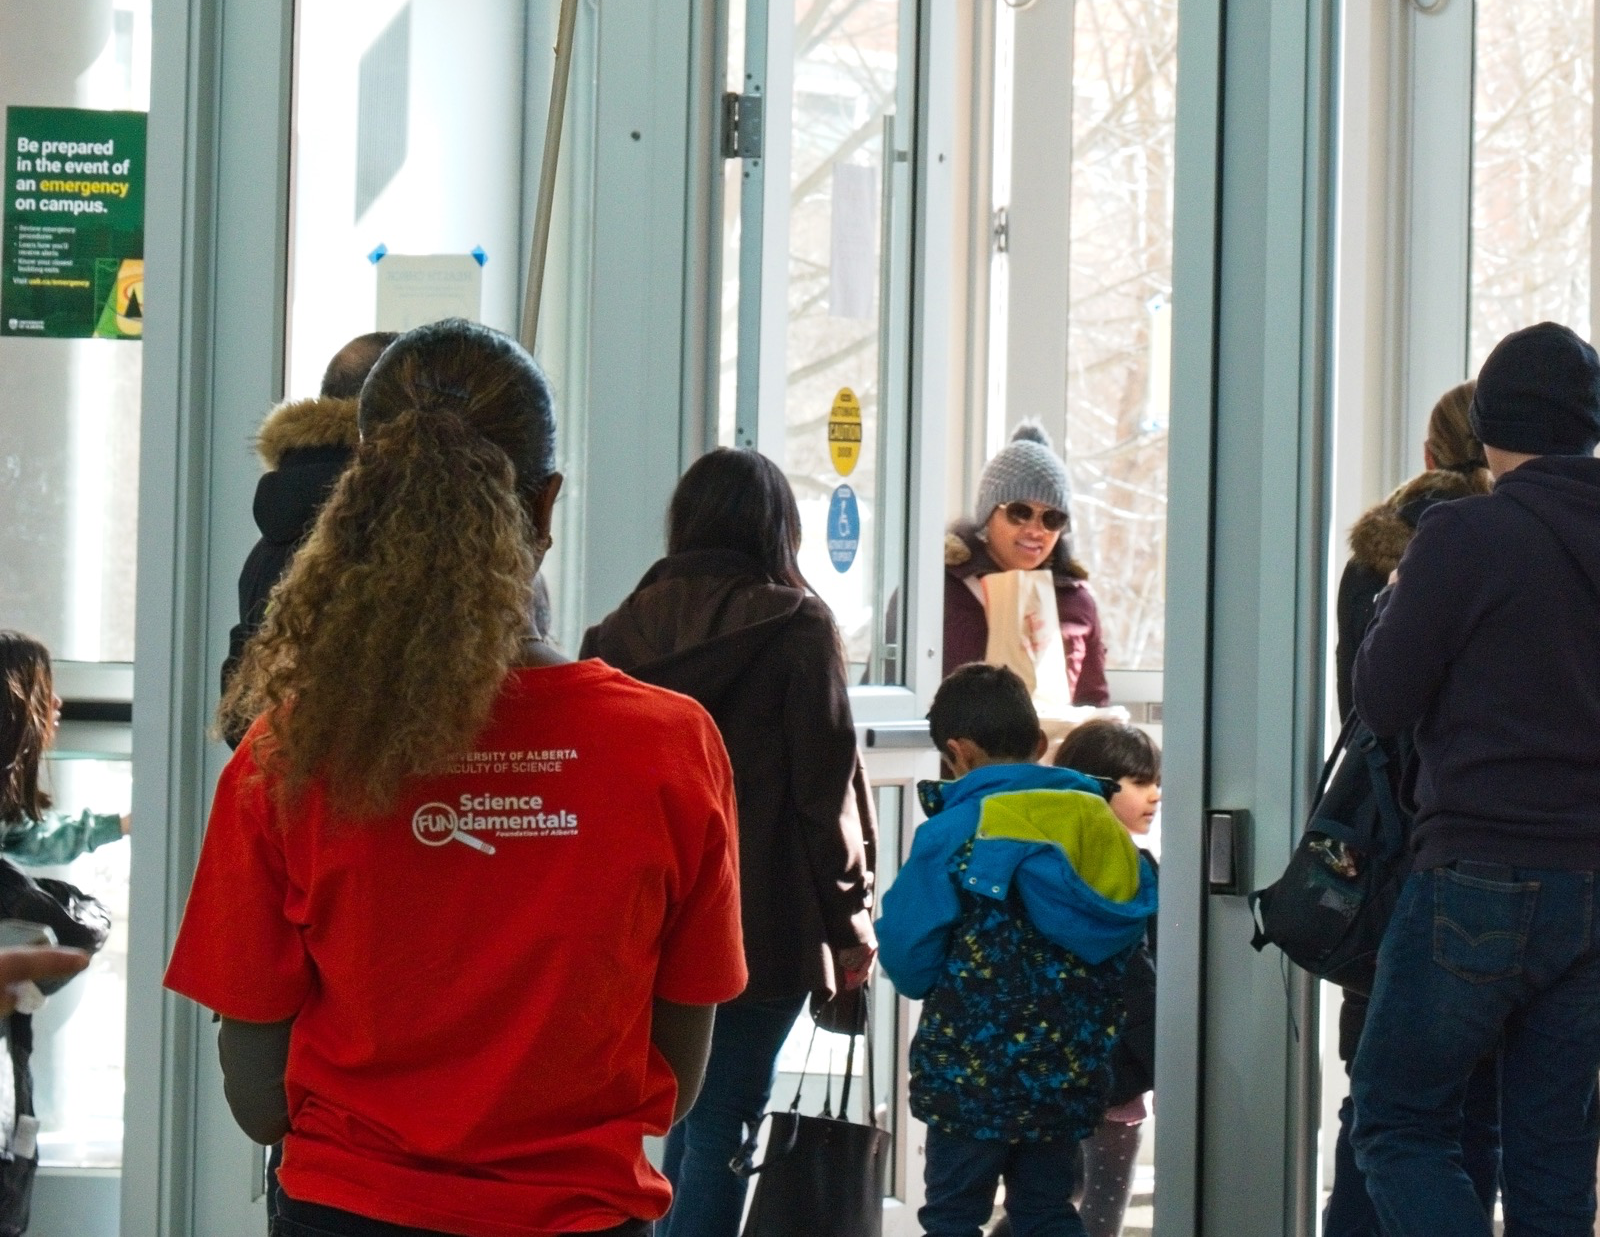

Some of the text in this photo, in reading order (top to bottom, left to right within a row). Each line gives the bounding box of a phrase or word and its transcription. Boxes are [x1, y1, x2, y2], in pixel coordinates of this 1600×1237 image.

[17, 137, 114, 158] Be prepared
[16, 156, 130, 175] in the event of
[16, 178, 129, 198] an emergency
[15, 197, 108, 216] on campus.
[509, 751, 524, 761] OF
[526, 749, 578, 761] ALBERTA
[447, 762, 562, 774] ACULTY OF SCIENCE
[460, 793, 543, 811] Science
[495, 829, 538, 838] Foundation
[550, 829, 579, 837] Alberta
